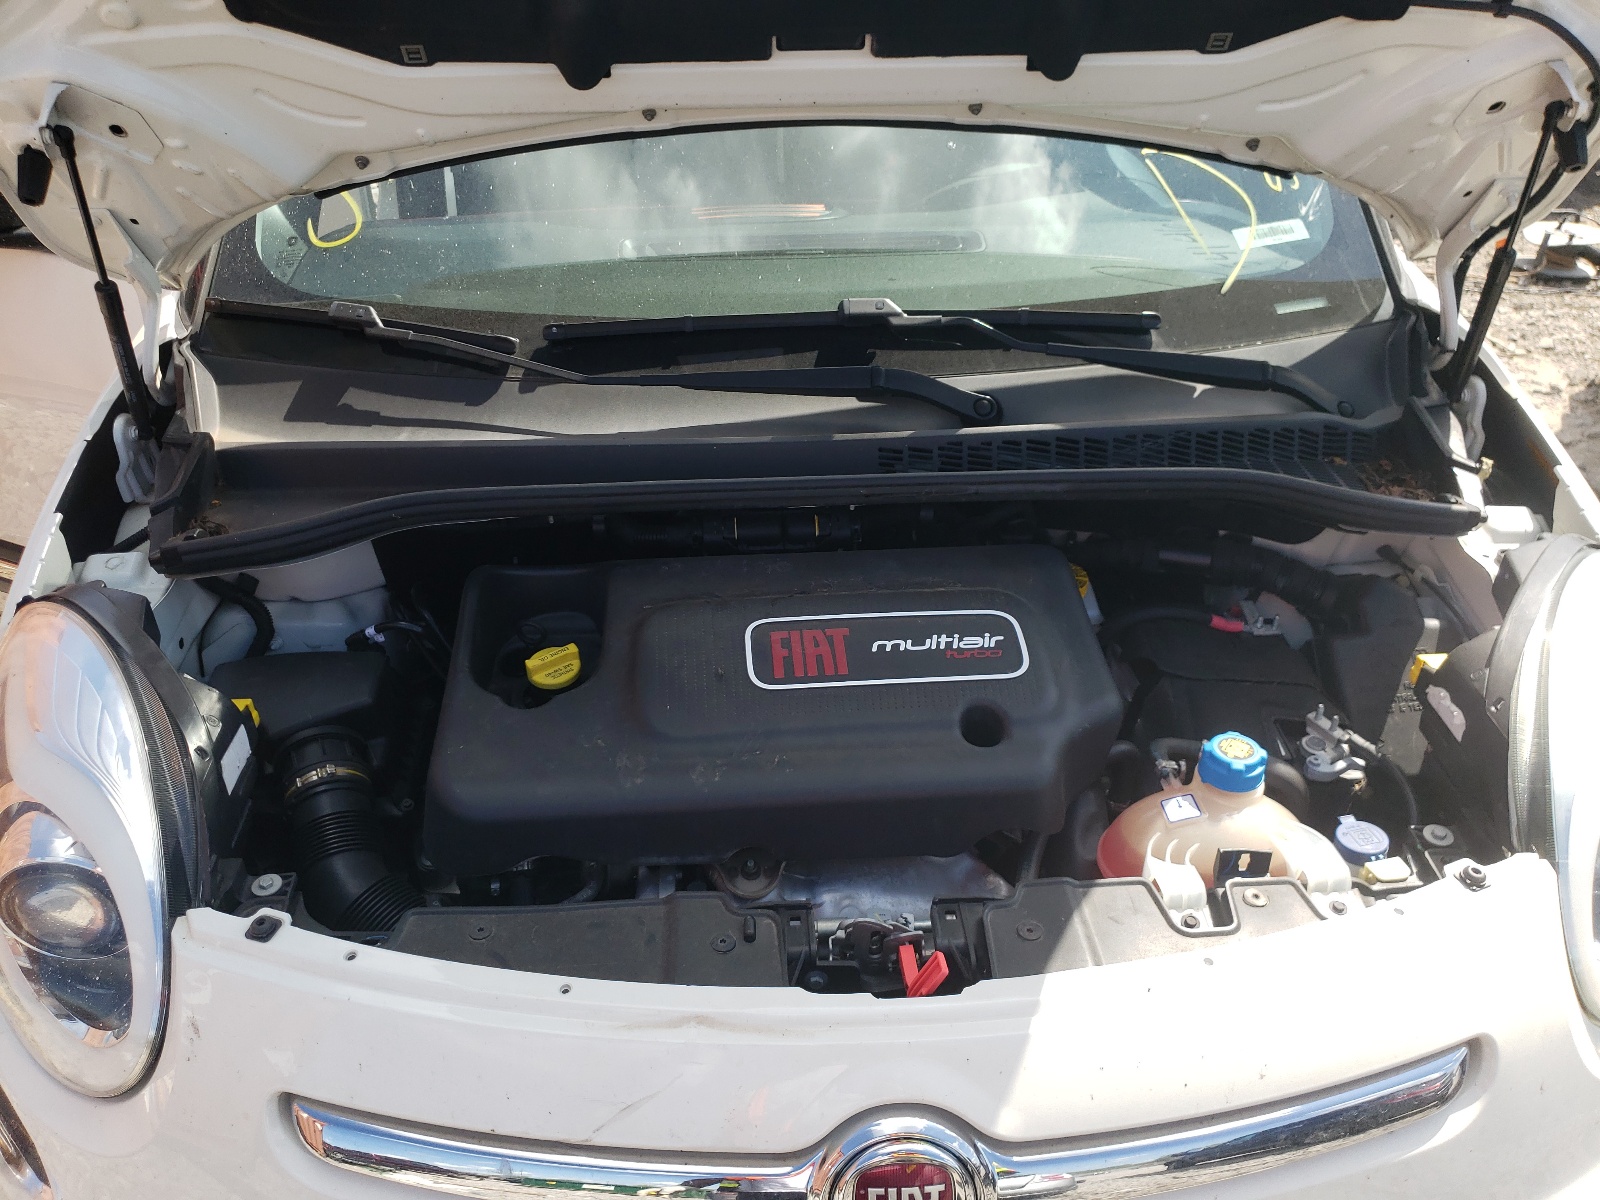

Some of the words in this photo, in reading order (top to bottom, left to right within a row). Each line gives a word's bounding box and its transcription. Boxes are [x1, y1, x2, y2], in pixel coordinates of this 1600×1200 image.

[872, 632, 1005, 652] multiair
[549, 646, 570, 658] ENGINE
[770, 628, 850, 679] FIAT
[945, 649, 1003, 659] turbo
